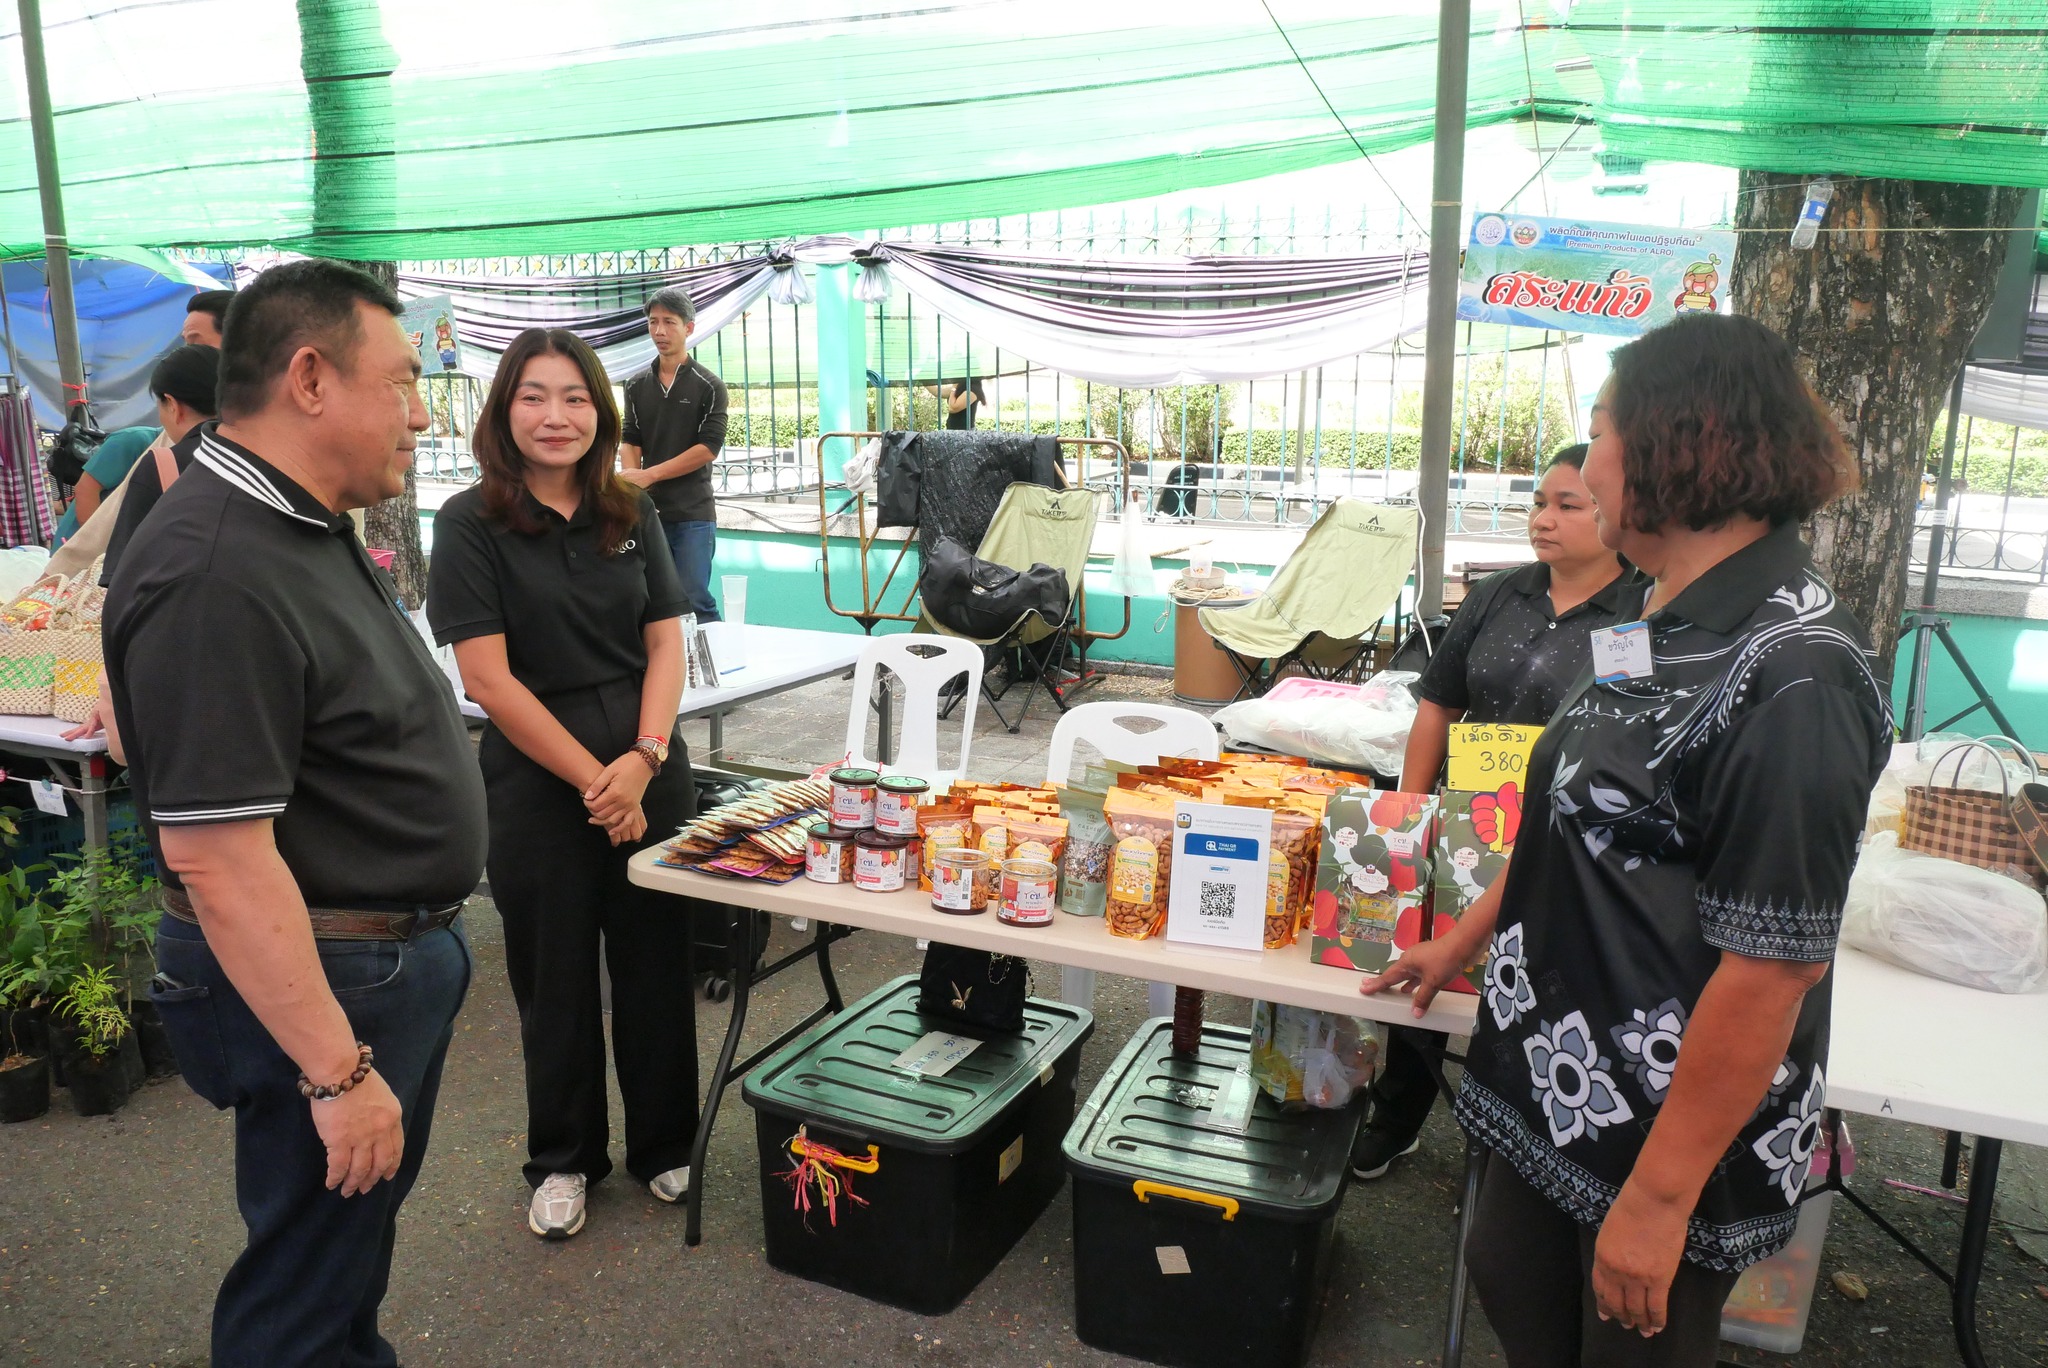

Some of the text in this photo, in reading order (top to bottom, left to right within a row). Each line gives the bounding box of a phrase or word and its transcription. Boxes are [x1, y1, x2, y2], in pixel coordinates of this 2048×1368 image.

[1549, 225, 1696, 247] ผลิตภัณฑ์คุณภาพในเขตปฏิรูปที่ดิน
[1567, 240, 1601, 249] (Premium
[1604, 243, 1637, 253] Products
[1650, 248, 1674, 257] ALRO)
[1485, 269, 1653, 318] สระแก้ว
[1608, 636, 1633, 651] ขวัญใจ
[1881, 1099, 1893, 1114] A
